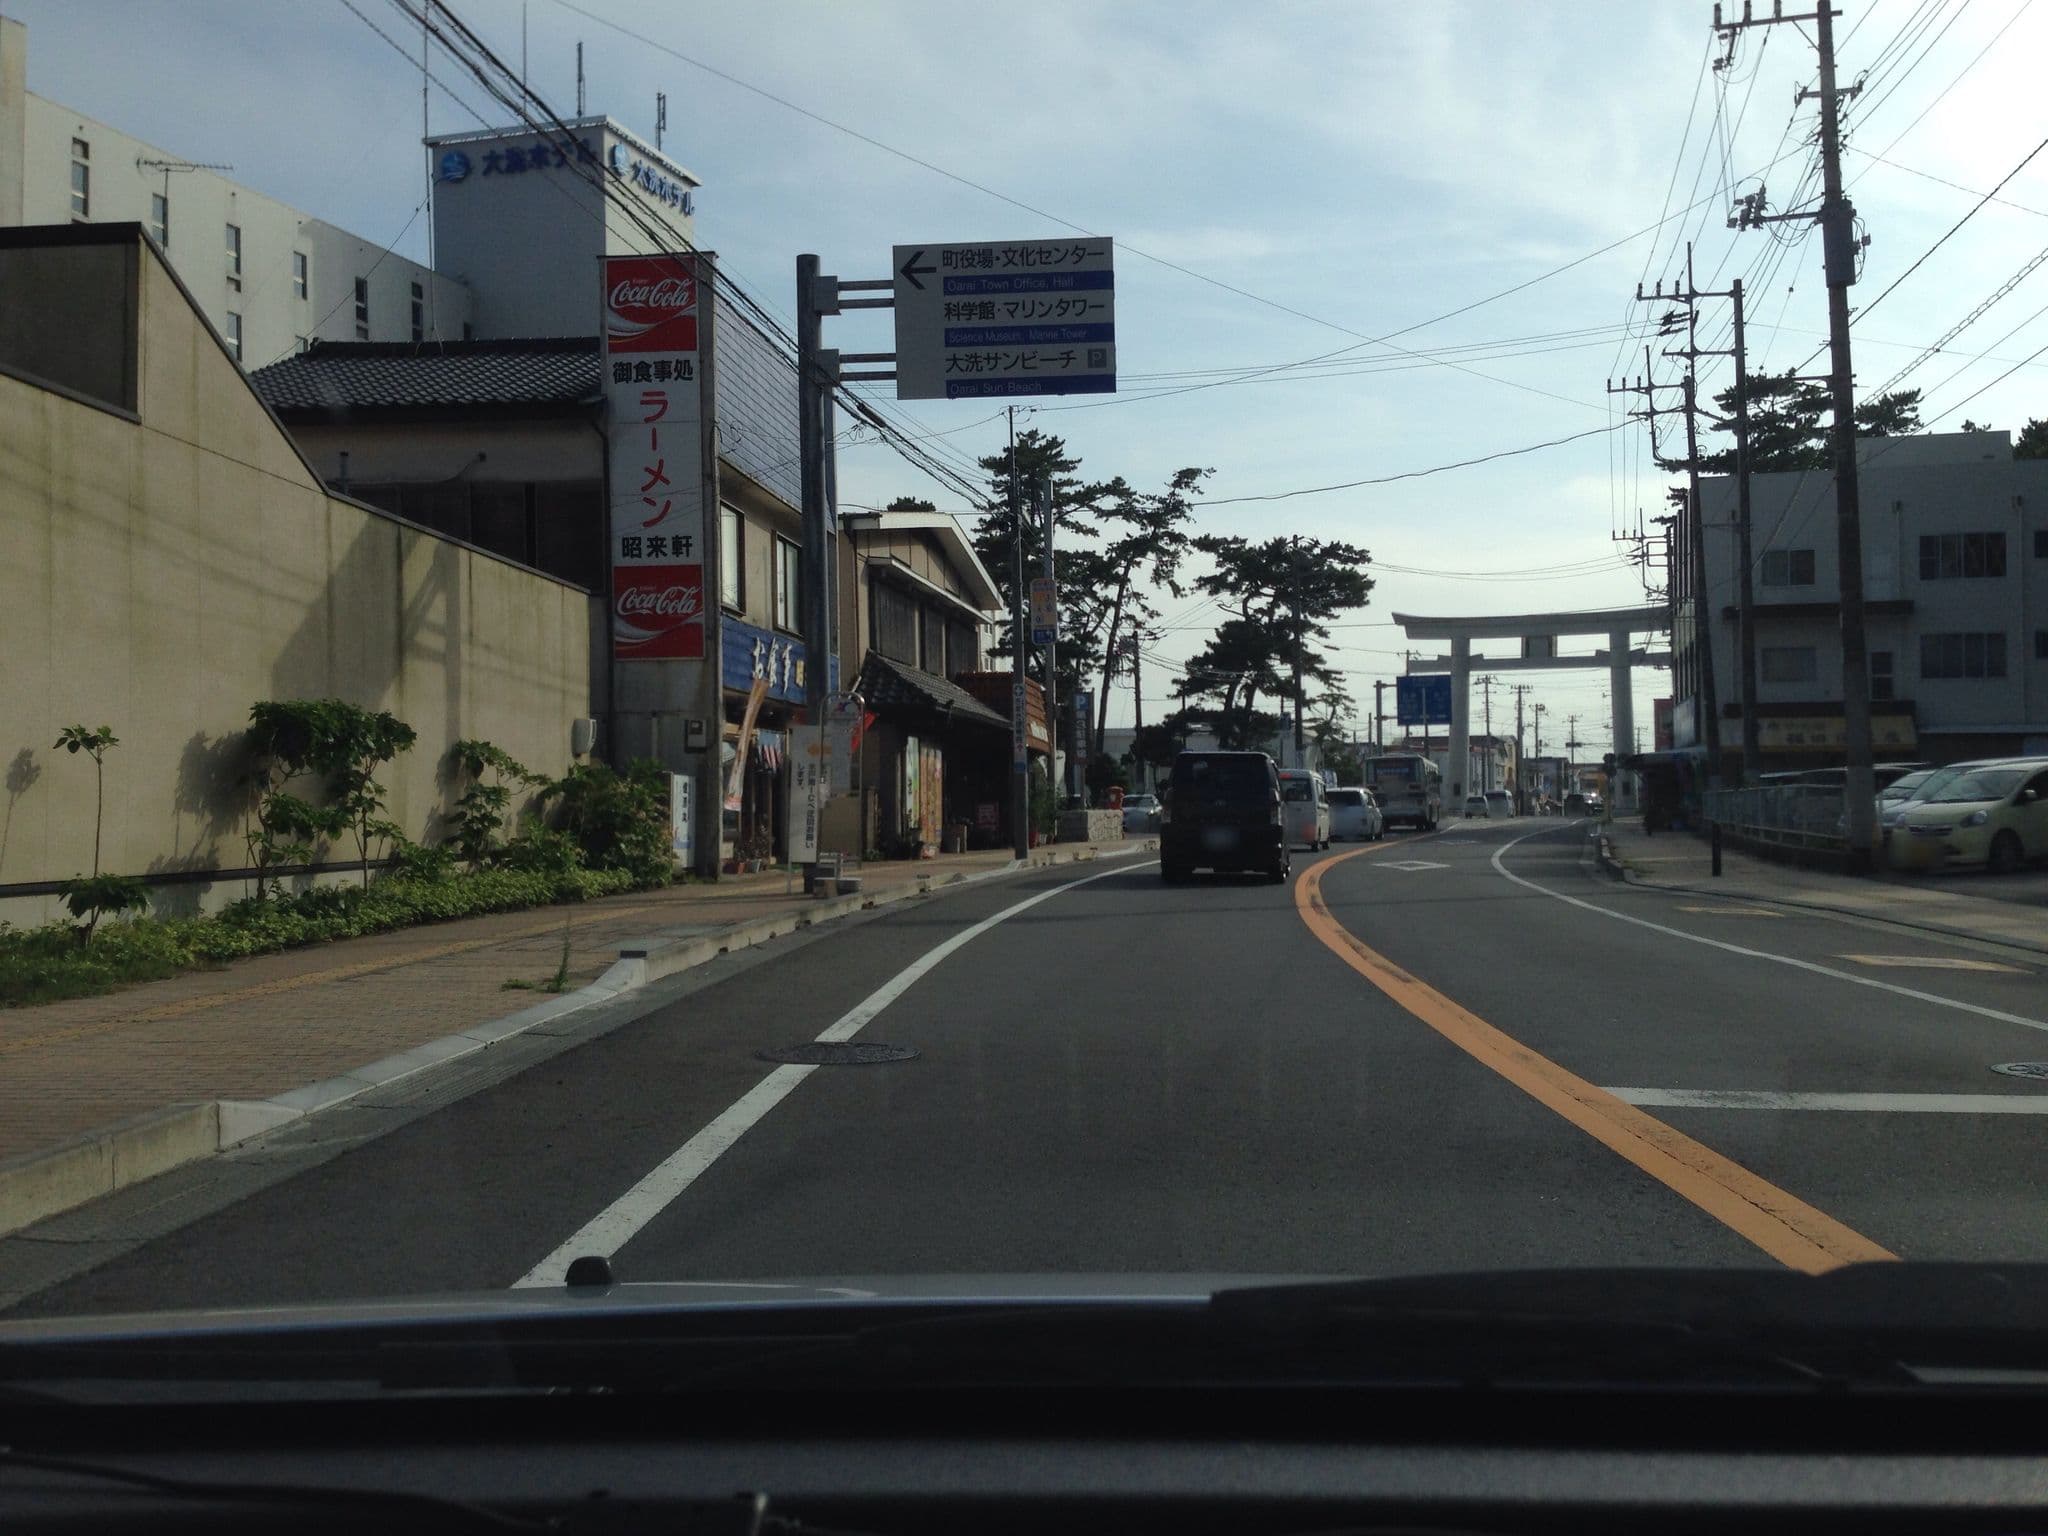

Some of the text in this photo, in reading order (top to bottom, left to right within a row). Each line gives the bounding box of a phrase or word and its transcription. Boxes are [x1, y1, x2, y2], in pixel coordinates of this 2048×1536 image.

[942, 245, 1105, 270] 町役場・文化センター
[610, 278, 693, 309] Coca-Cola
[947, 279, 976, 292] Oarai
[982, 278, 1009, 290] Town
[1053, 275, 1074, 288] Hall
[944, 298, 1105, 322] 科学館・マリンタワー
[949, 331, 984, 345] Science
[1061, 328, 1087, 339] Tower
[945, 350, 1077, 374] 大洗サンビーチ
[1092, 352, 1102, 365] P
[612, 358, 694, 385] 御食事処
[983, 382, 1004, 394] Sun
[1008, 380, 1042, 393] Beach
[640, 391, 672, 528] ラーメン
[621, 534, 693, 559] 昭来軒
[617, 585, 701, 616] Coca-Cola
